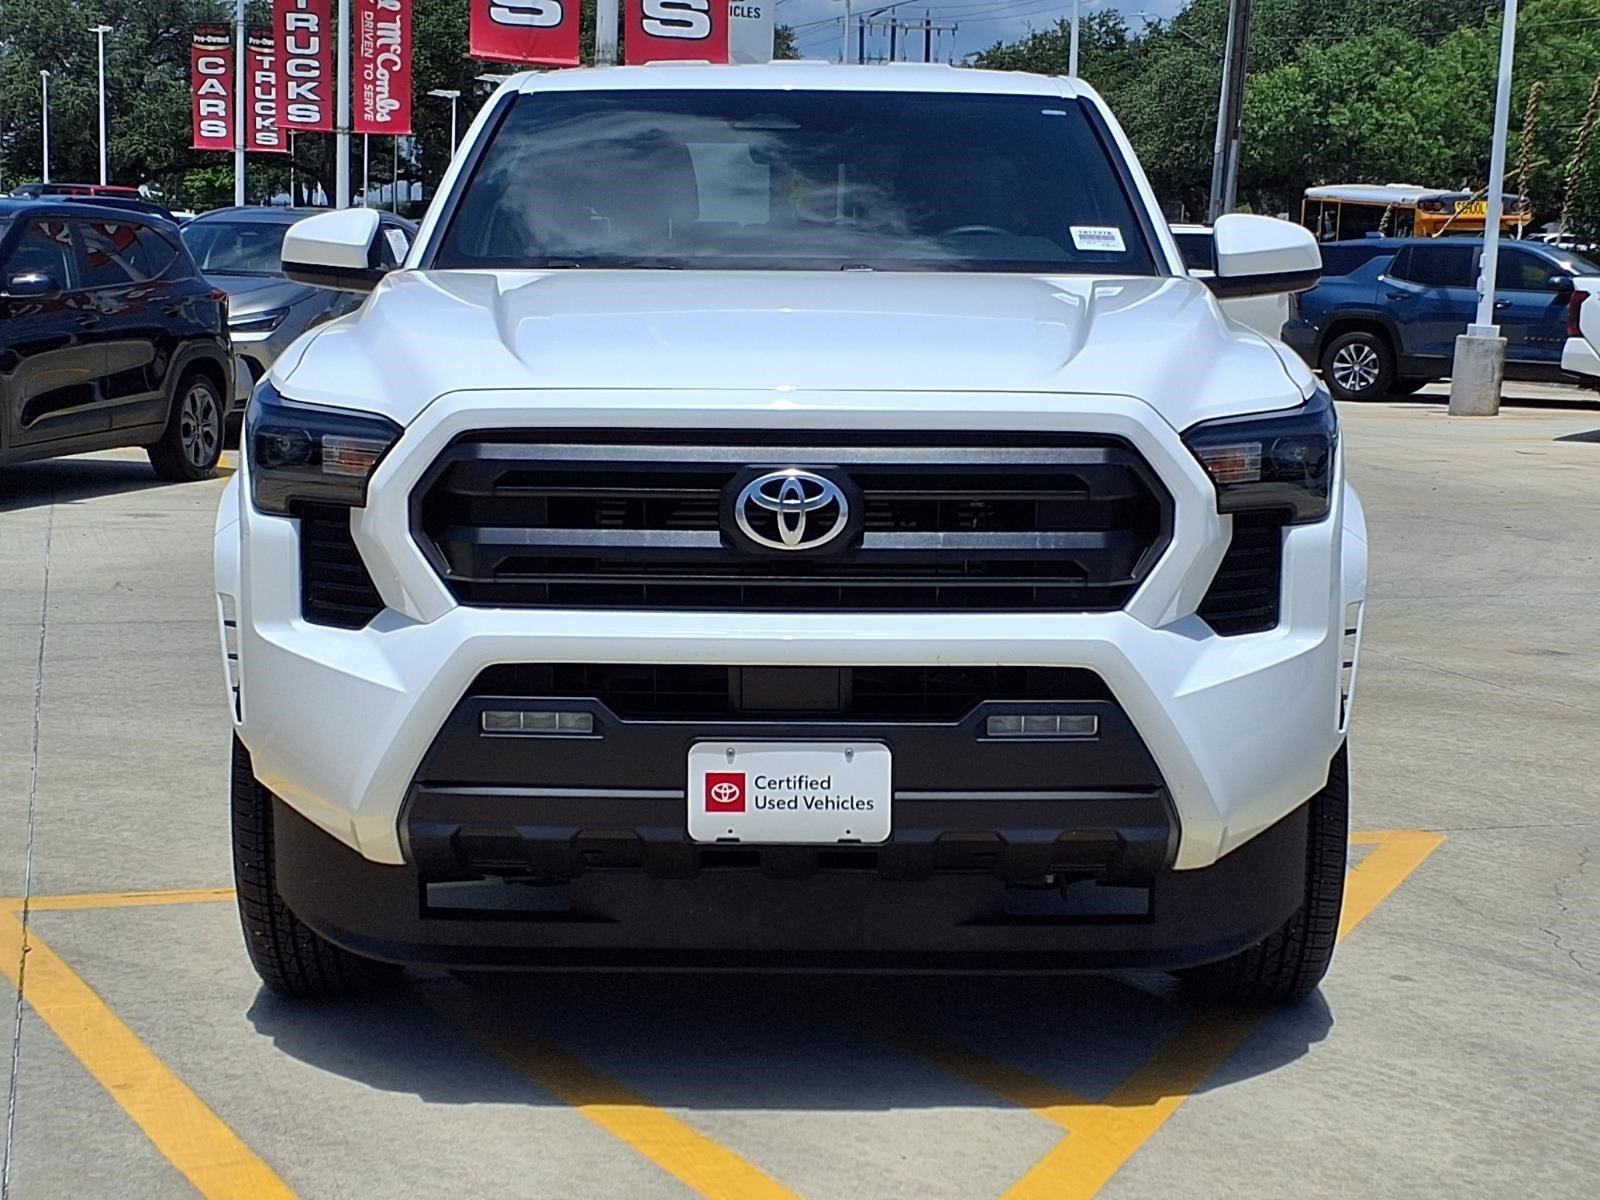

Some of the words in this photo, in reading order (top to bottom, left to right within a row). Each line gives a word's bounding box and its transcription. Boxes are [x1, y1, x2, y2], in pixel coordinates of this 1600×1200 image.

[363, 10, 374, 58] DRIVEN
[363, 63, 374, 80] TO
[376, 14, 402, 122] McCombs
[197, 56, 228, 138] CARS
[254, 55, 279, 146] TRUCKS
[363, 84, 375, 122] SERVE
[754, 775, 831, 790] Certified
[754, 795, 798, 810] Used
[803, 796, 874, 811] Vehicles
